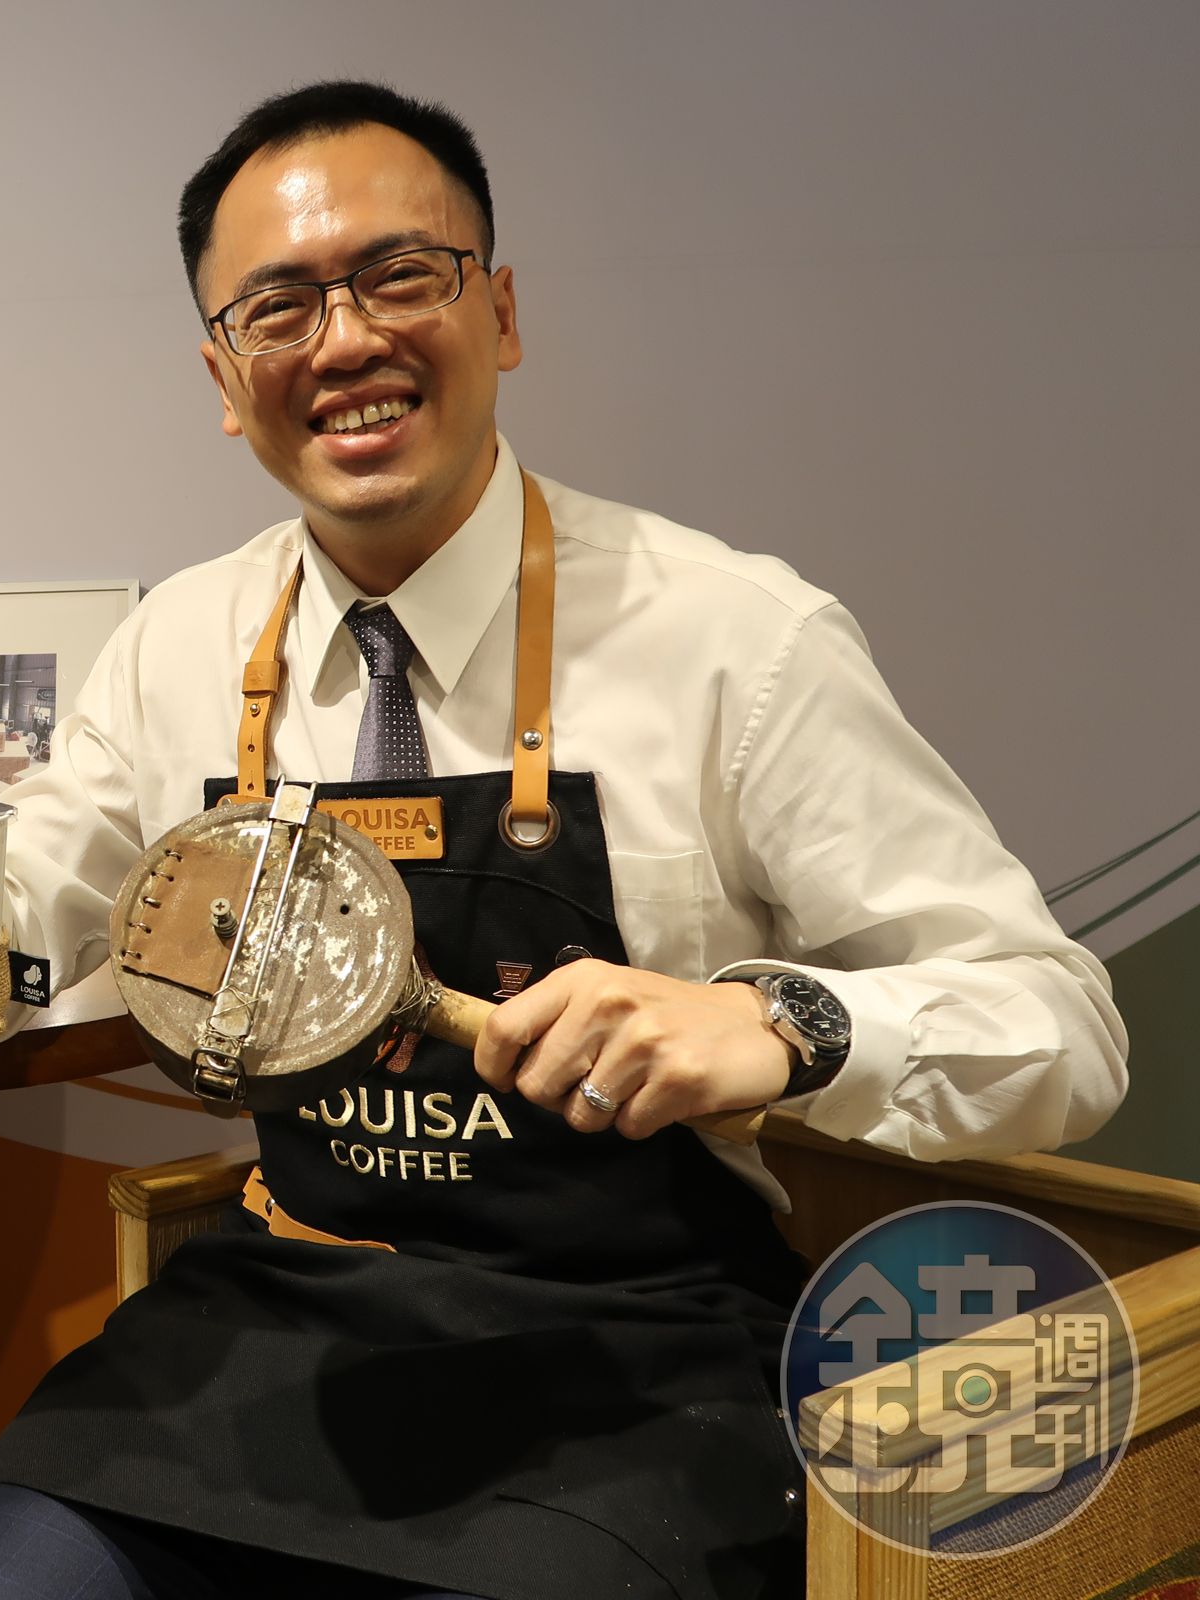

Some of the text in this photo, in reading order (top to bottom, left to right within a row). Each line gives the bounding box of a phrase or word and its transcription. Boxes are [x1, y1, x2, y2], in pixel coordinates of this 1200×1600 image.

[327, 808, 431, 831] OUISA
[20, 985, 45, 998] LOUISA
[331, 1139, 473, 1181] COFFEE
